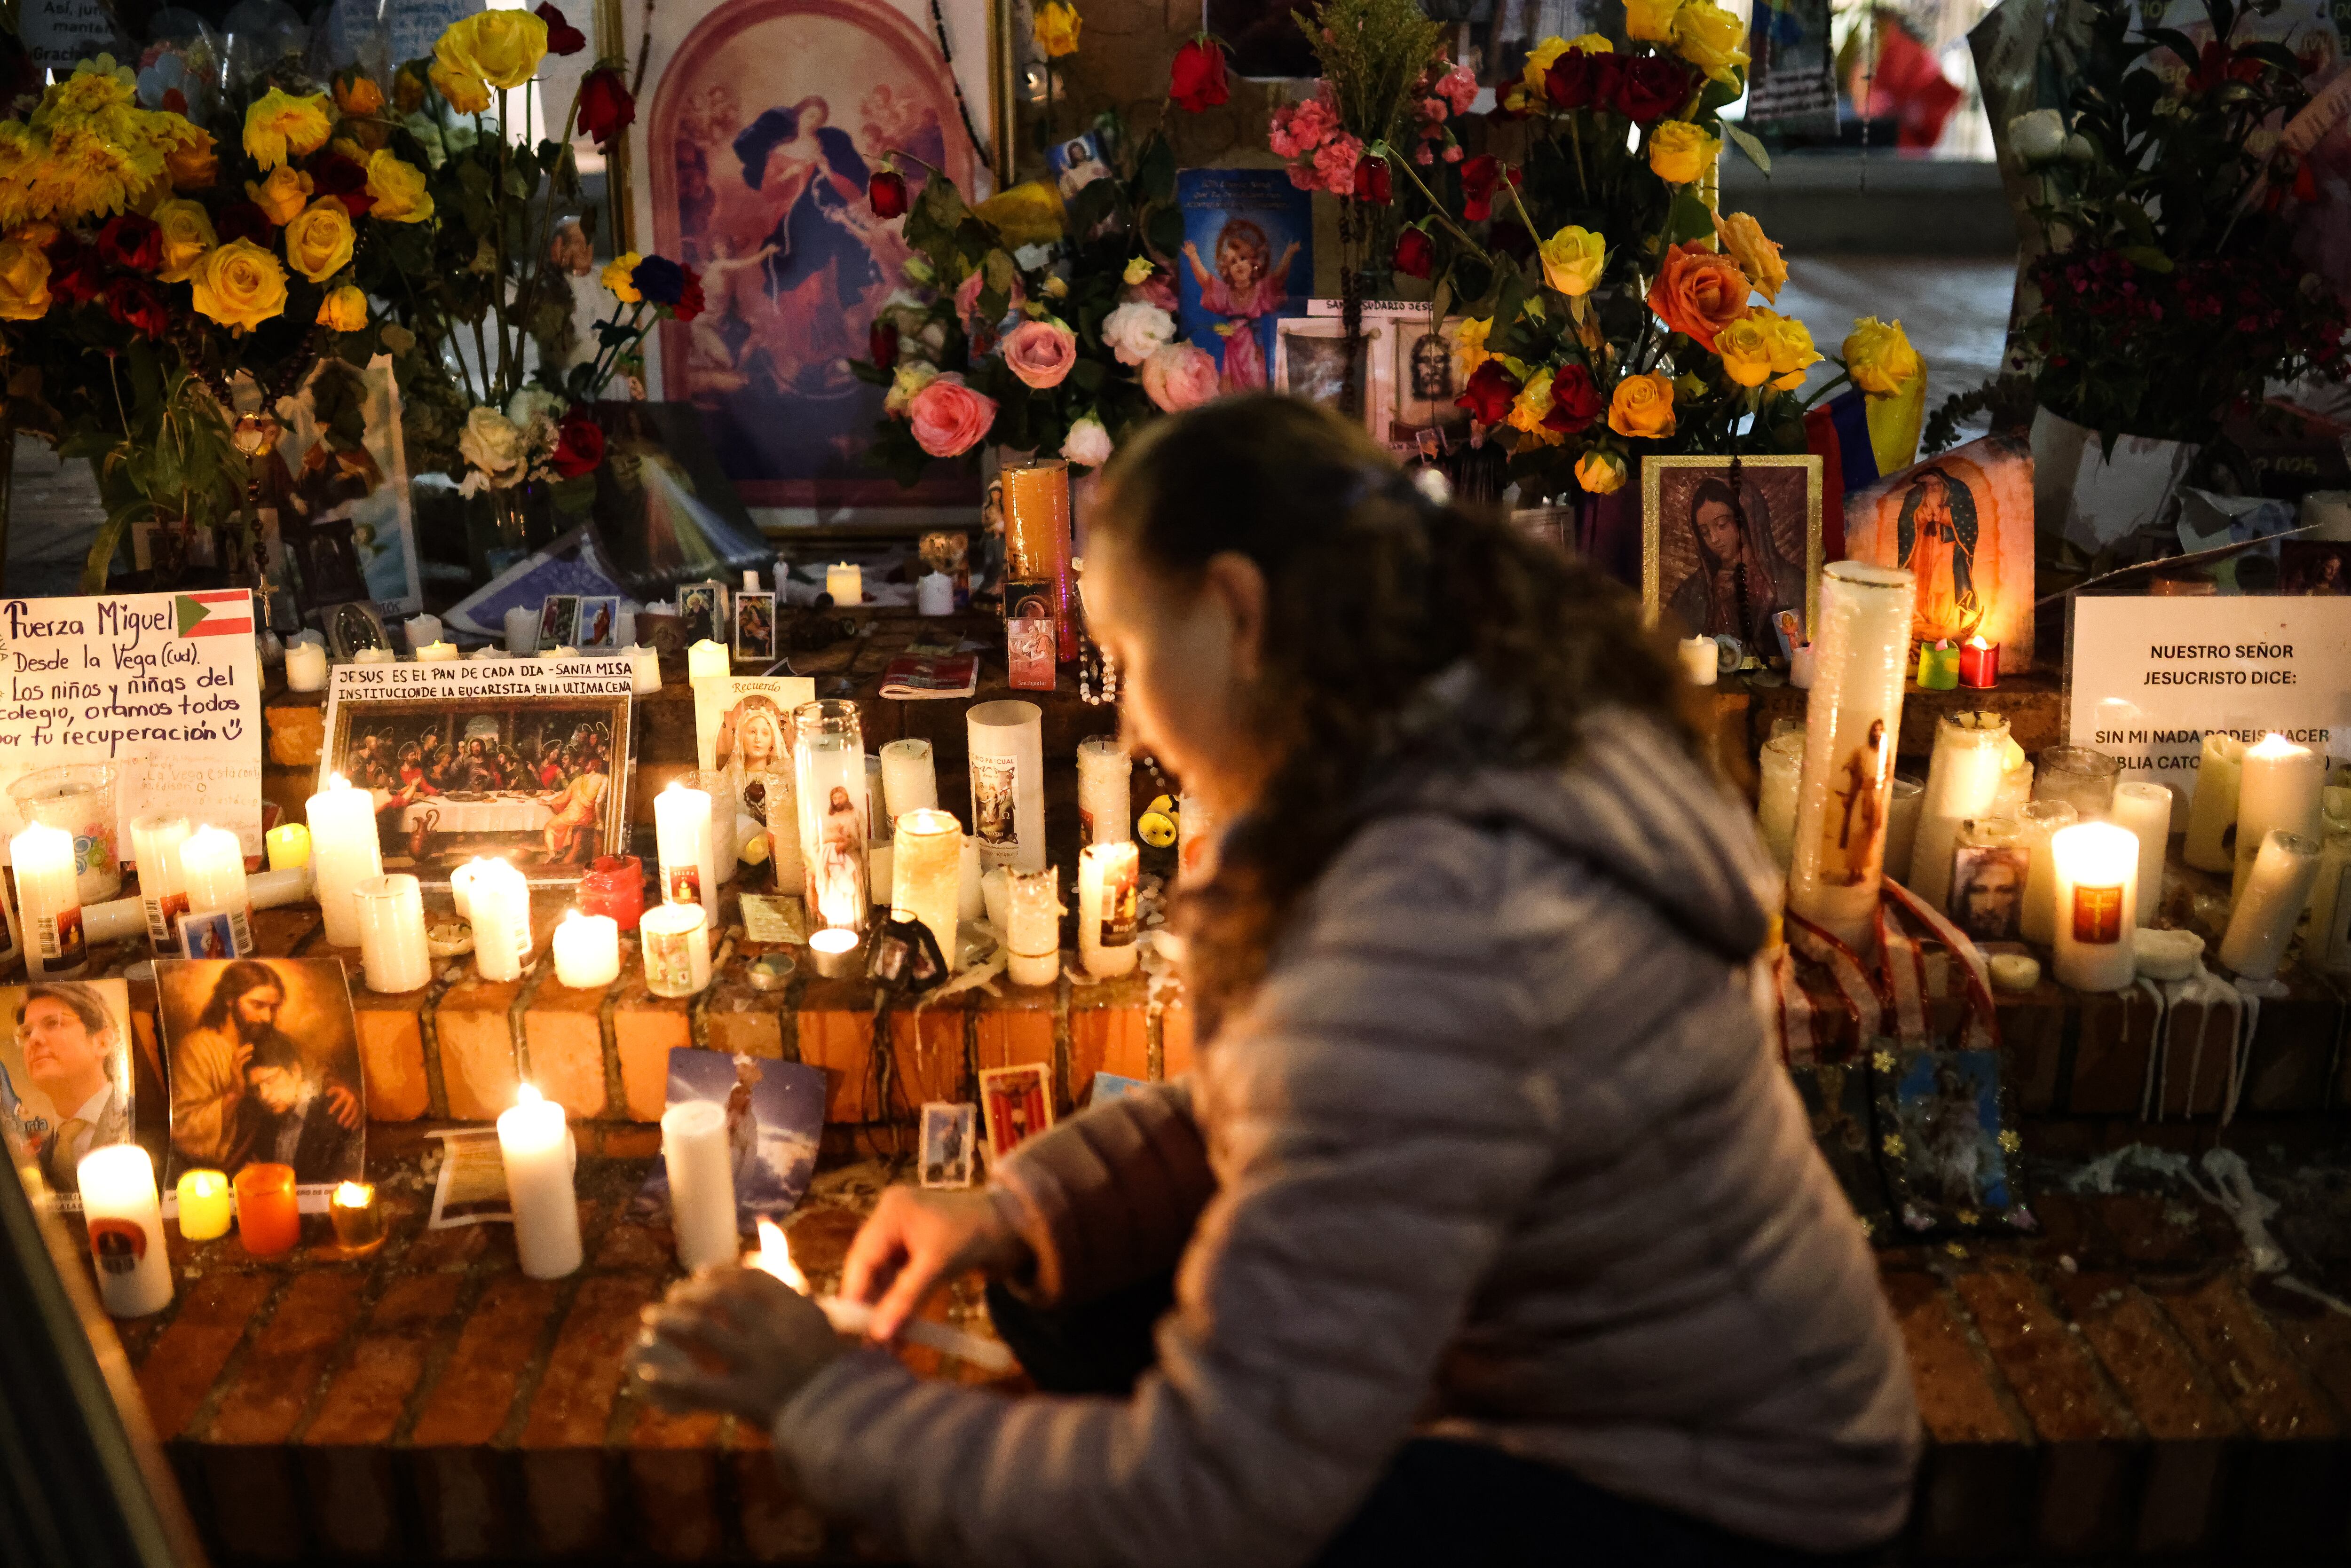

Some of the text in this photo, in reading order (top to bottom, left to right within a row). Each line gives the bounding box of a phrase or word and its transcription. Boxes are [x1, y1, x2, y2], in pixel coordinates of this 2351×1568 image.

[1362, 301, 1405, 311] SUDARIO
[3, 600, 173, 651] Fuerza Miguel
[2151, 641, 2293, 659] NUESTRO SEÑOR
[12, 648, 69, 673] Desde
[84, 644, 101, 669] la
[112, 643, 157, 678] Vega
[340, 670, 384, 684] JESUS
[393, 670, 407, 682] ES
[412, 669, 426, 681] EL
[431, 668, 455, 680] PAN
[462, 667, 478, 679] DE
[482, 666, 515, 678] CADA
[520, 665, 544, 677] DIA
[555, 663, 591, 675] SANTA
[596, 662, 632, 675] MISA
[2144, 671, 2296, 685] JESUCRISTO DICE:
[12, 665, 234, 709] Los niños y niñas del
[442, 686, 455, 697] LA
[458, 683, 531, 697] EUCARISTIA
[535, 683, 547, 694] EN
[549, 683, 560, 694] LA
[563, 681, 604, 694] ULTIMA
[605, 680, 632, 693] CENA
[732, 681, 781, 693] Recuerdo
[85, 702, 173, 719] oramos
[178, 693, 240, 716] todos
[31, 725, 53, 747] tu
[63, 719, 217, 759] recuperación
[2095, 730, 2124, 743] SIN
[2129, 730, 2147, 743] MI
[2153, 730, 2200, 743] NADA
